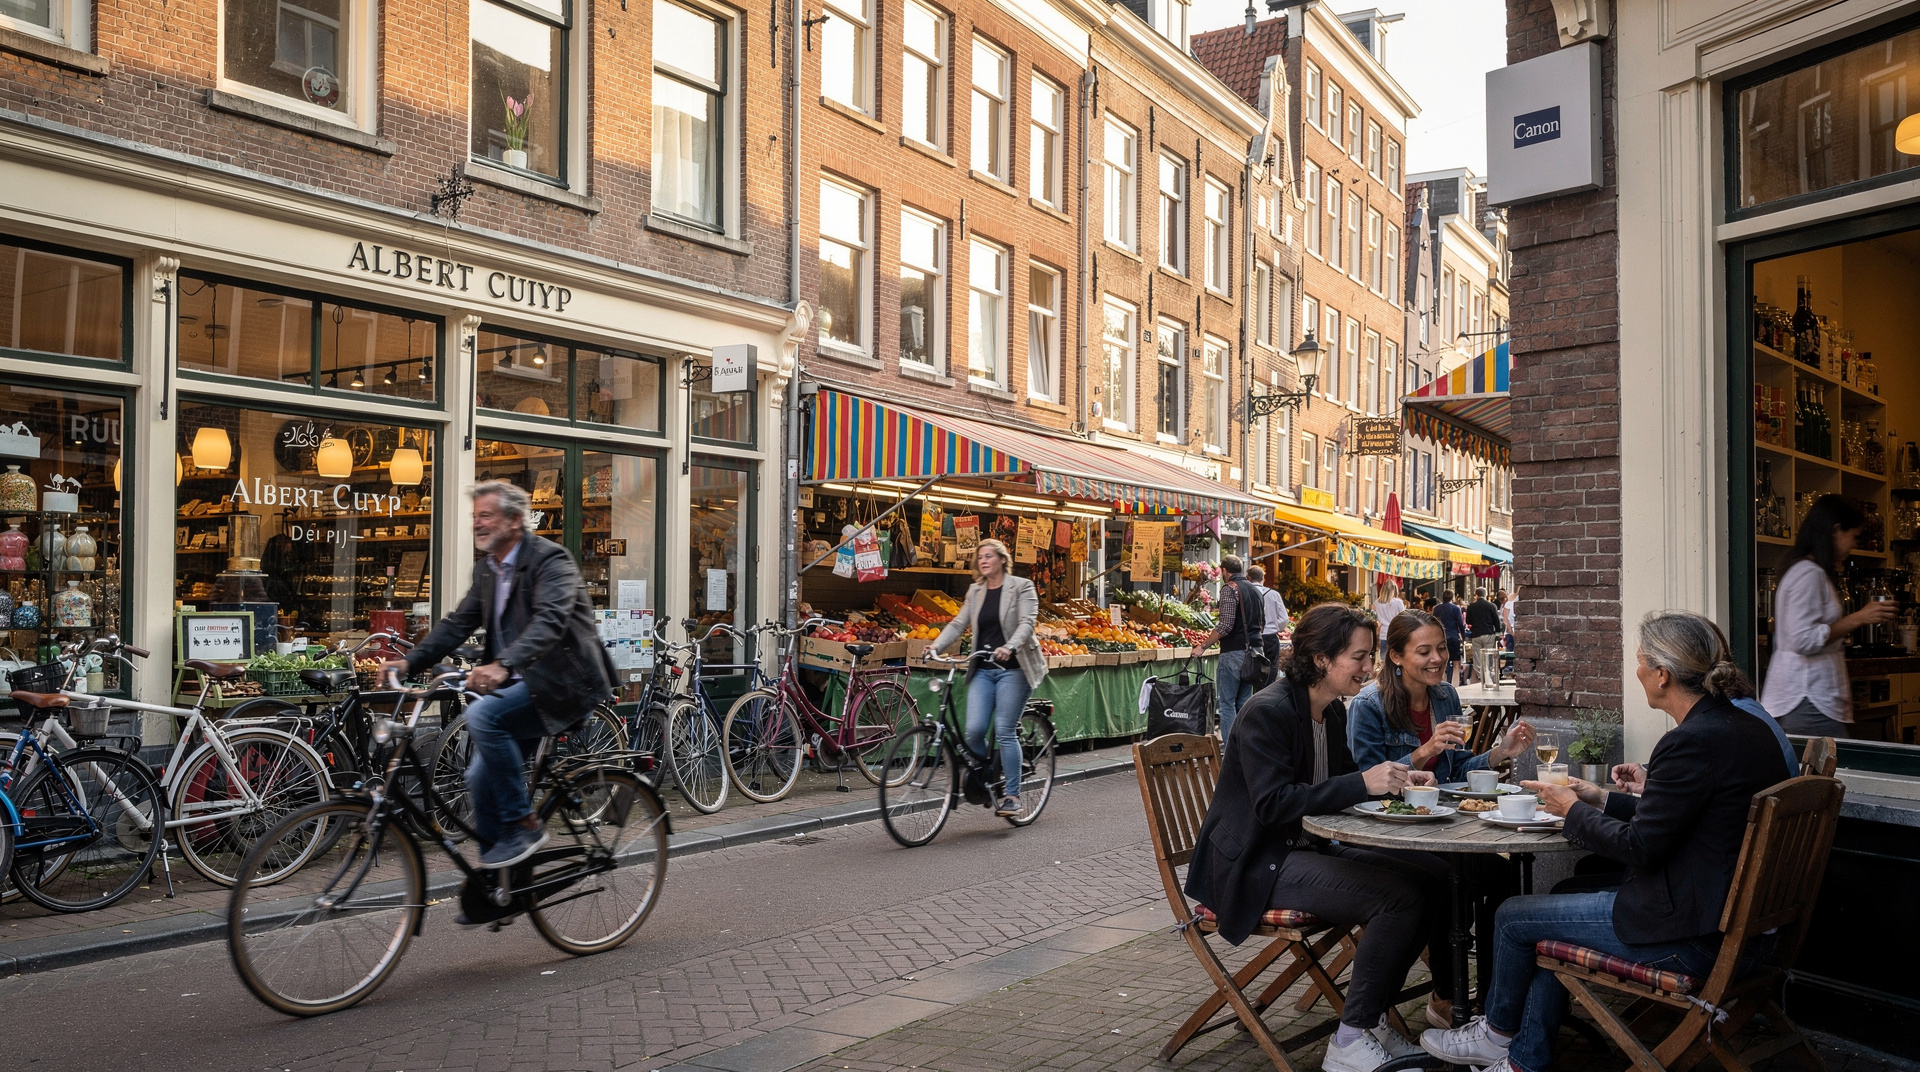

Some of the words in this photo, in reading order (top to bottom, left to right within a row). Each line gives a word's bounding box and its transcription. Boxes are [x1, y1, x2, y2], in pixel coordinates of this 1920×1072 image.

[1514, 120, 1560, 140] Canon
[347, 241, 474, 292] ALBERT
[488, 271, 572, 313] CUIYP
